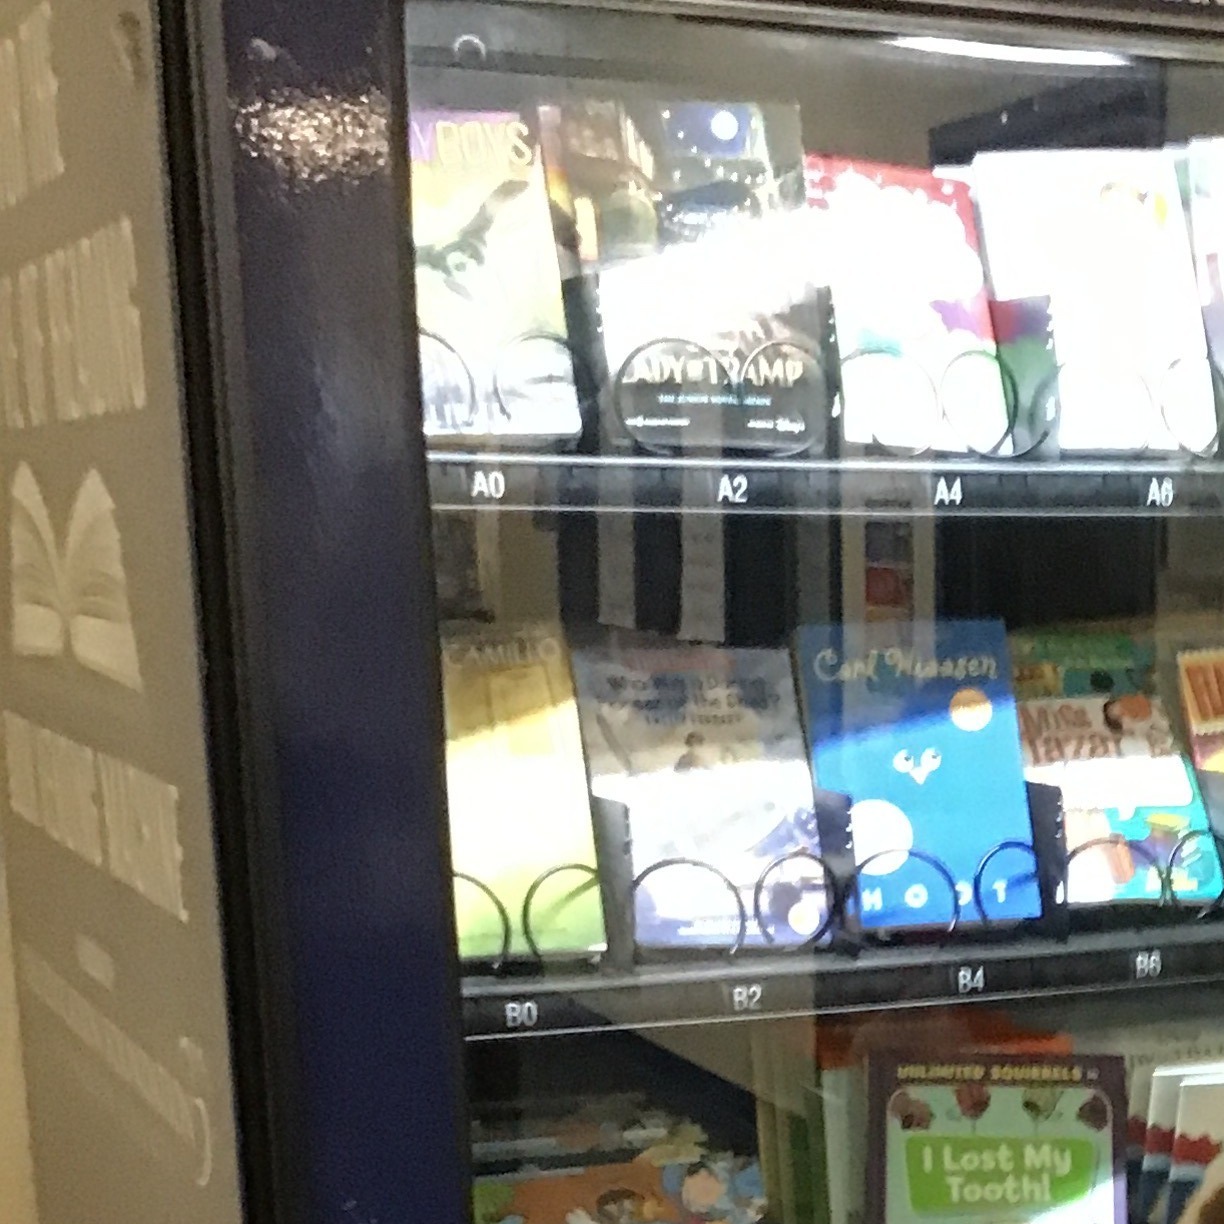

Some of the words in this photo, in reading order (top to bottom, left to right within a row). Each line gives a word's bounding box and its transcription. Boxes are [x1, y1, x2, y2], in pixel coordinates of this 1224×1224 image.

[471, 470, 505, 499] A0
[717, 473, 749, 503] A2
[933, 476, 963, 506] A4
[957, 966, 985, 994] B4
[732, 984, 763, 1011] B2
[505, 1000, 539, 1028] B0
[923, 1145, 933, 1174] I
[943, 1142, 1015, 1173] Lost
[1024, 1143, 1072, 1177] My
[945, 1173, 1051, 1204] Tooth!
